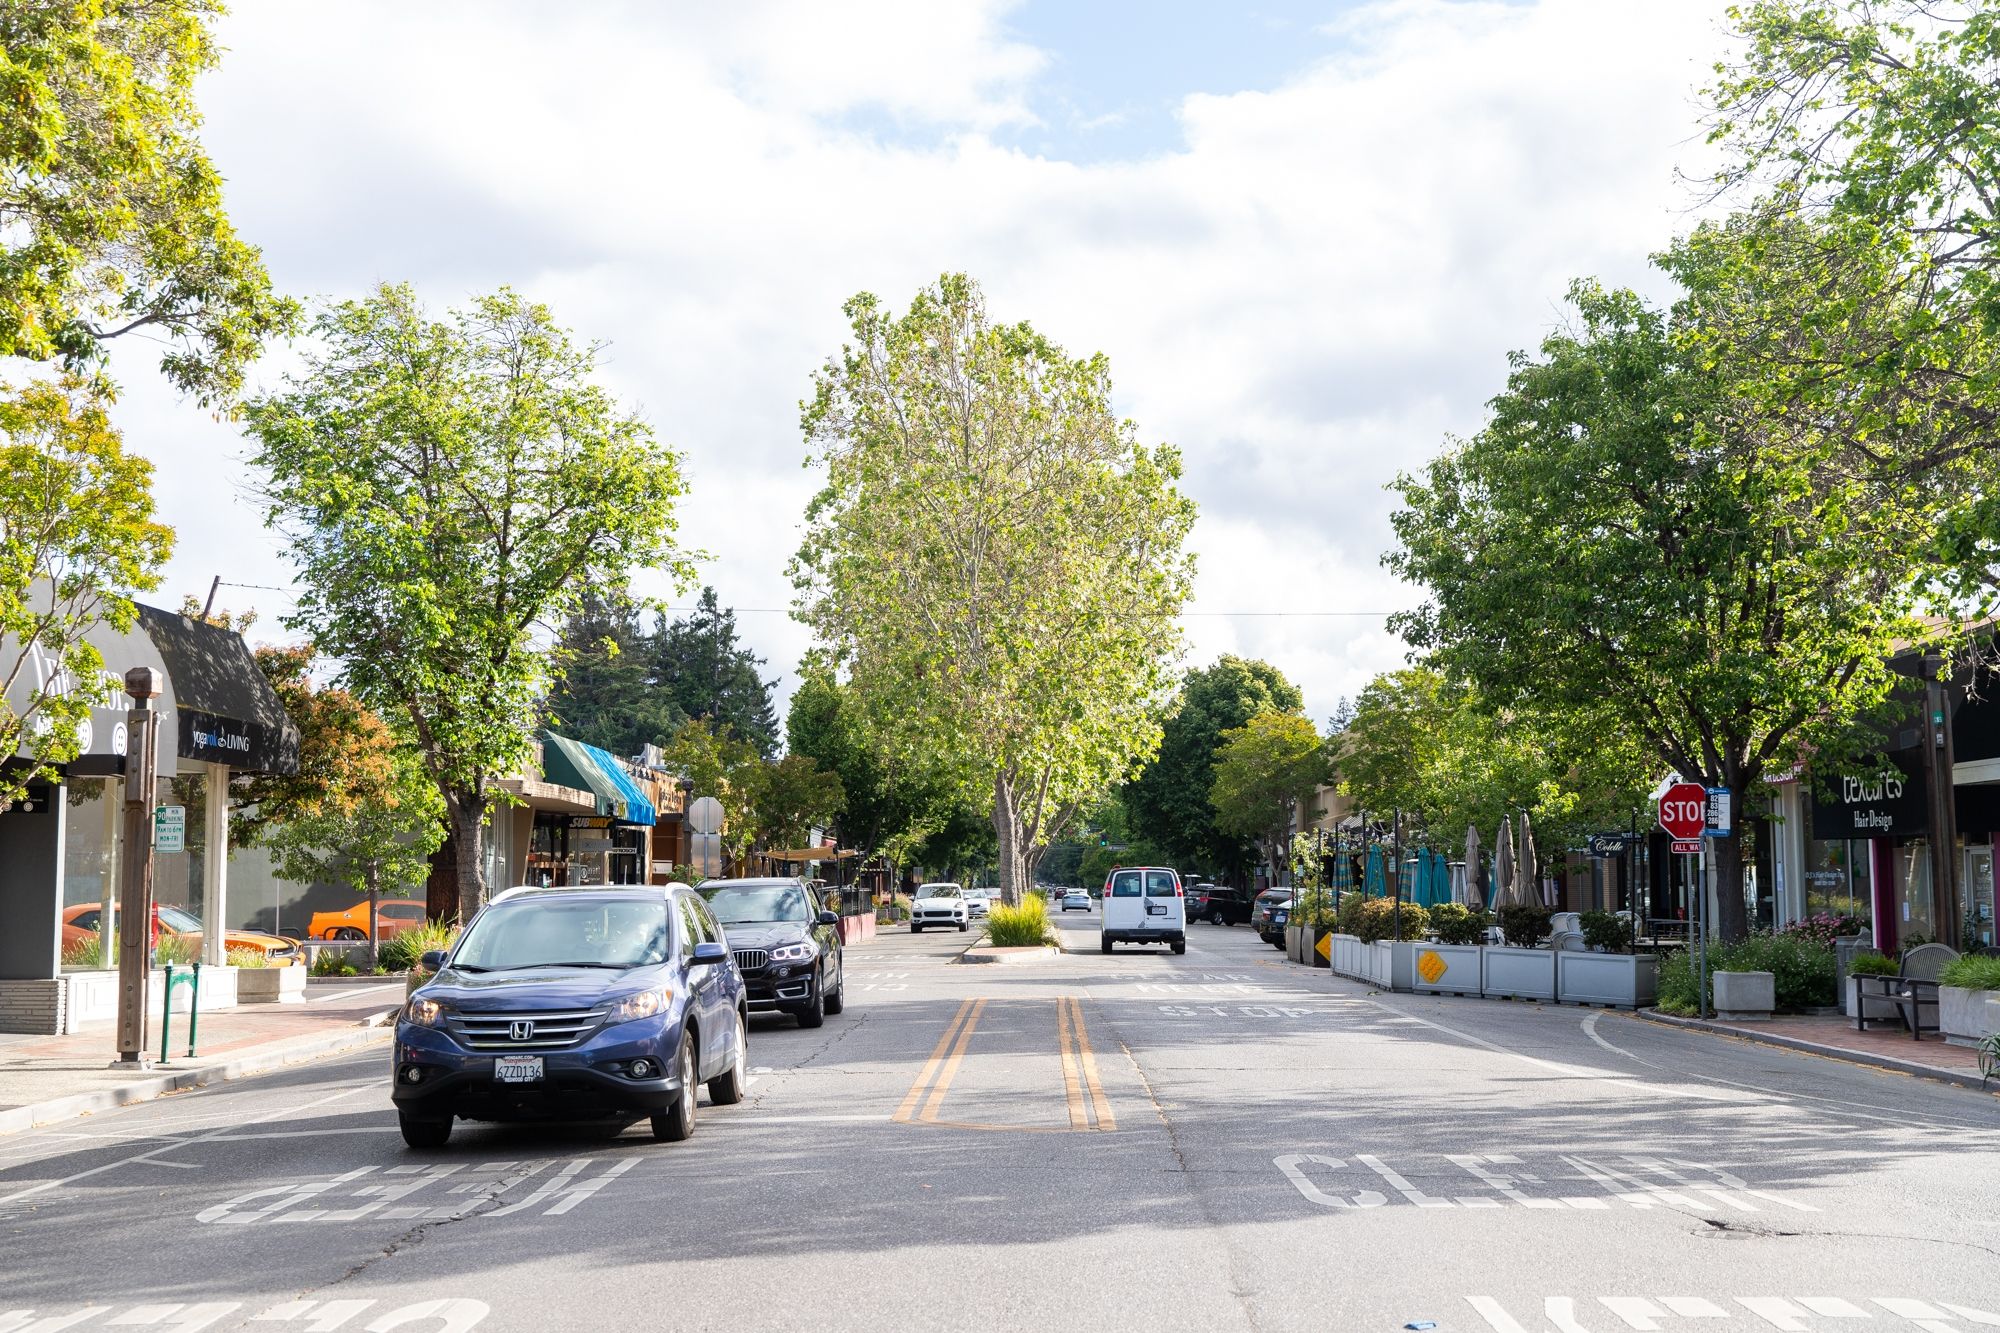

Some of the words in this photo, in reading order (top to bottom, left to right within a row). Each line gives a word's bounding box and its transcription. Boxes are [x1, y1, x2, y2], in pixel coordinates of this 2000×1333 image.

[227, 733, 250, 752] LIVING
[569, 817, 609, 828] SUBWAY
[1854, 810, 1869, 828] Hair
[1869, 809, 1893, 832] Design
[1674, 843, 1688, 852] ALL
[1157, 1005, 1313, 1018] STOP
[497, 1065, 542, 1078] 6ZZD136
[1272, 1154, 1823, 1212] CLEAR
